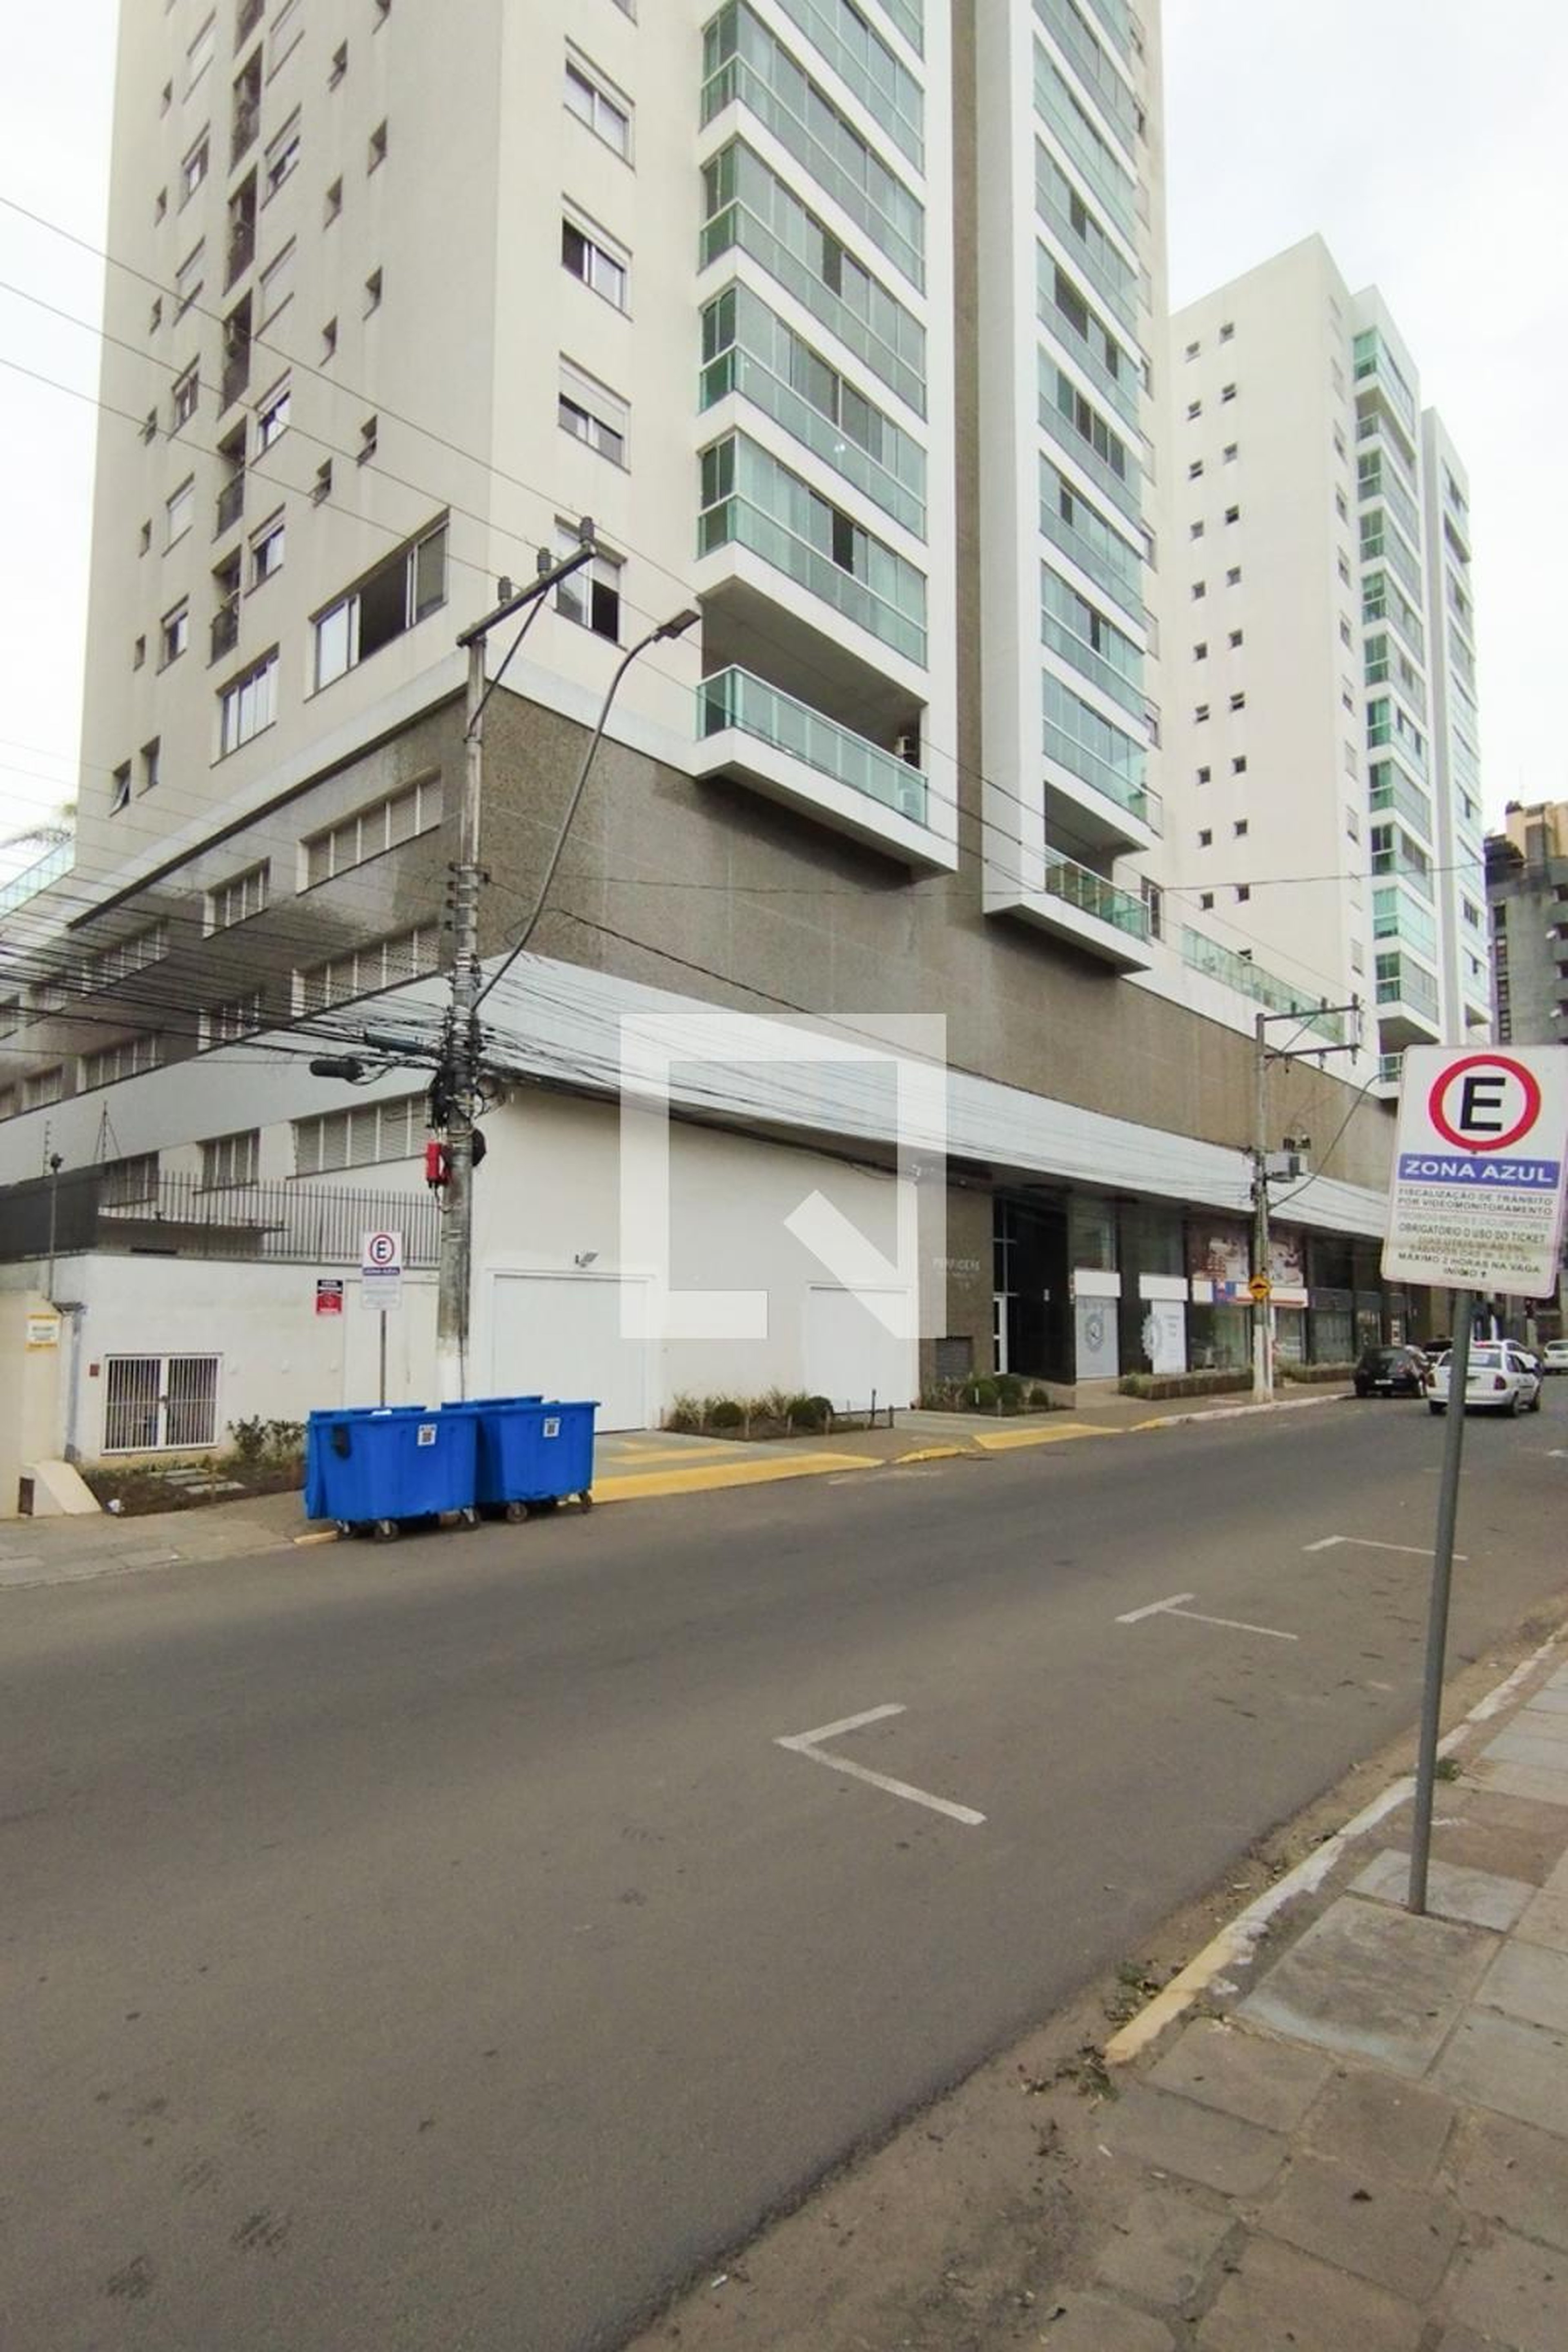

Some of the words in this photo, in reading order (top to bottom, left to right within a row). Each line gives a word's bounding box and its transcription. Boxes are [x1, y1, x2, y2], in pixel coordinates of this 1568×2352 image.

[1460, 1077, 1506, 1131] E
[1405, 1160, 1476, 1178] ZONA
[1482, 1165, 1552, 1183] AZUL
[1463, 1227, 1470, 1237] O
[1472, 1229, 1492, 1238] USO
[1494, 1230, 1508, 1240] DO
[1511, 1232, 1545, 1243] TICKET
[377, 1240, 387, 1259] E
[1451, 1258, 1488, 1267] HORAS
[1491, 1261, 1507, 1270] NA
[1510, 1264, 1541, 1273] VAGA
